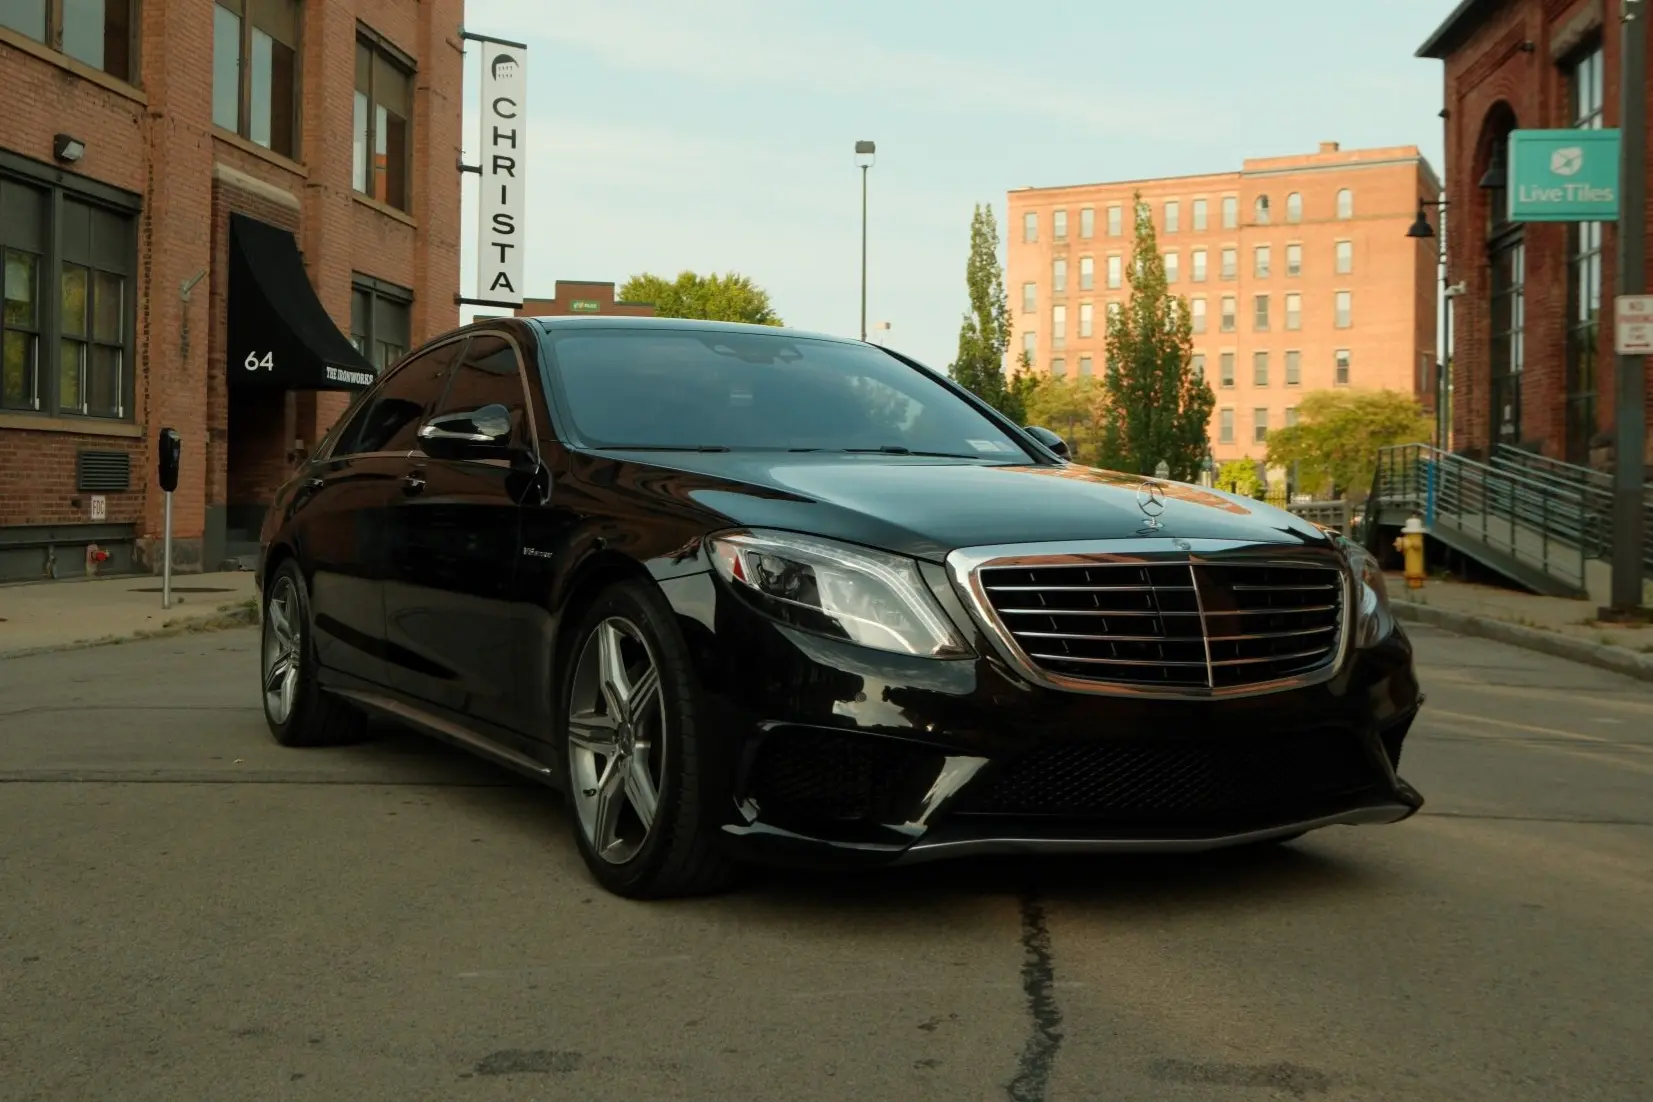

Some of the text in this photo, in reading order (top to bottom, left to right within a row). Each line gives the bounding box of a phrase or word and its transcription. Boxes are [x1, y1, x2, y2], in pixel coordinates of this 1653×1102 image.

[490, 97, 517, 293] CHRISTA
[1519, 184, 1614, 202] LiveTiles
[244, 351, 274, 371] 64
[326, 366, 373, 385] THE IRONWORKS
